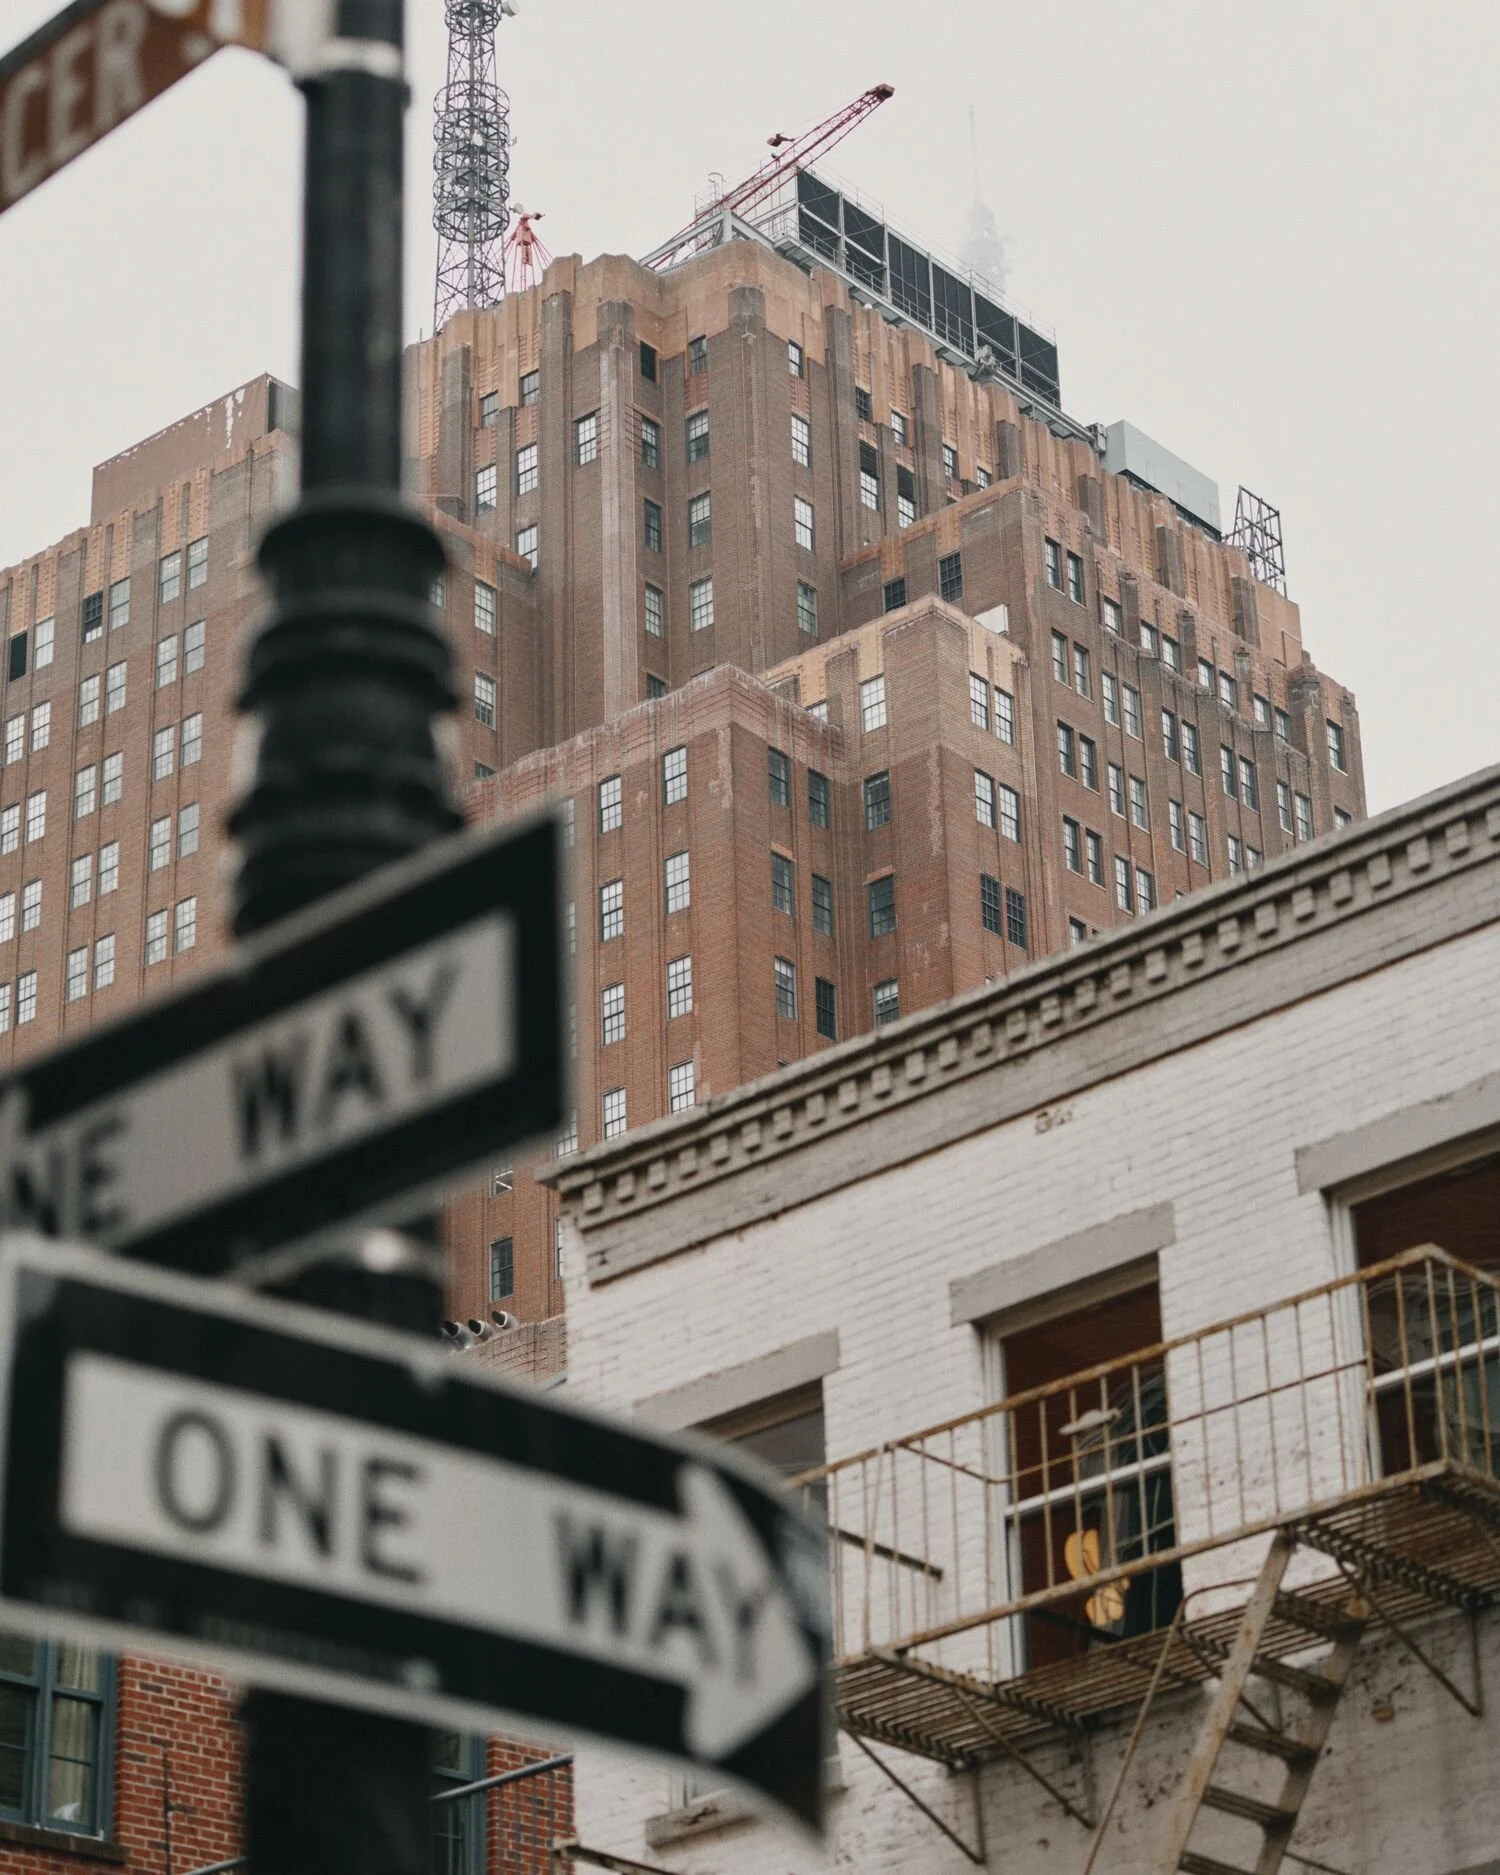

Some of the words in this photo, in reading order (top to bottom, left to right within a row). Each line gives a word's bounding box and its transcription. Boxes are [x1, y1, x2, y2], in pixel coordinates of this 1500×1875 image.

[229, 958, 462, 1163] WAY
[152, 1406, 428, 1586] ONE
[552, 1505, 775, 1695] WAY
